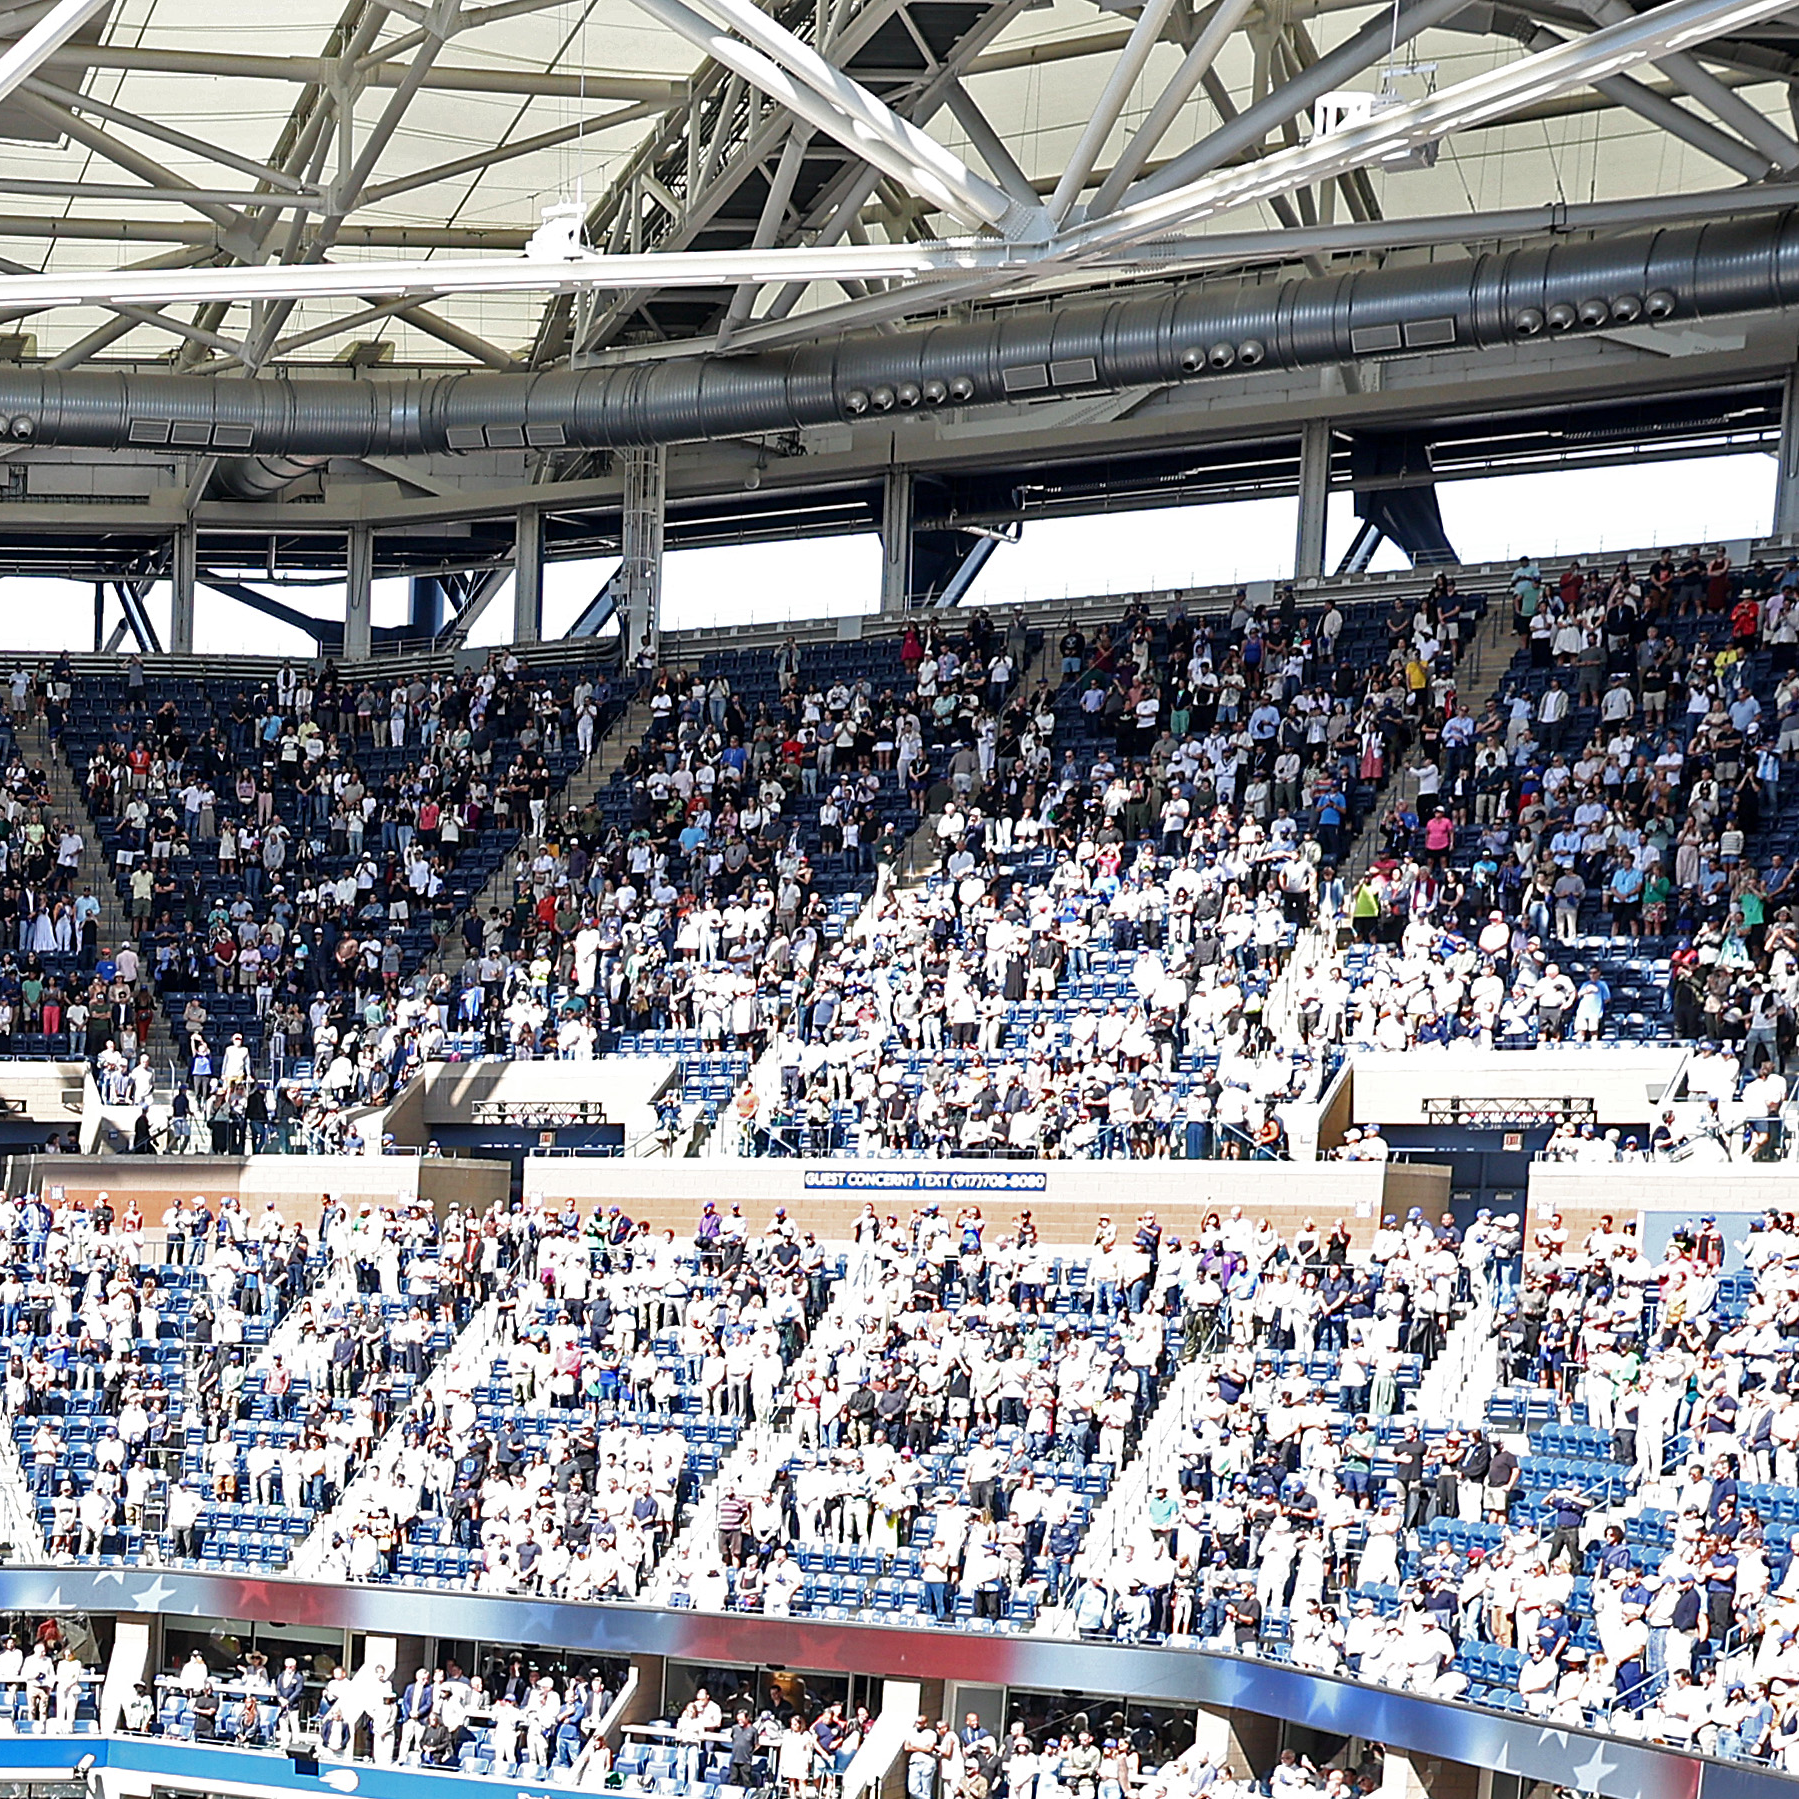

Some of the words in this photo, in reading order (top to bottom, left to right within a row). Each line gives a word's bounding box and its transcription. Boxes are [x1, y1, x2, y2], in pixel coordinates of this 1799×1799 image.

[805, 1171, 847, 1187] GUEST
[847, 1172, 915, 1188] CONCERN?
[916, 1173, 950, 1188] TEXT
